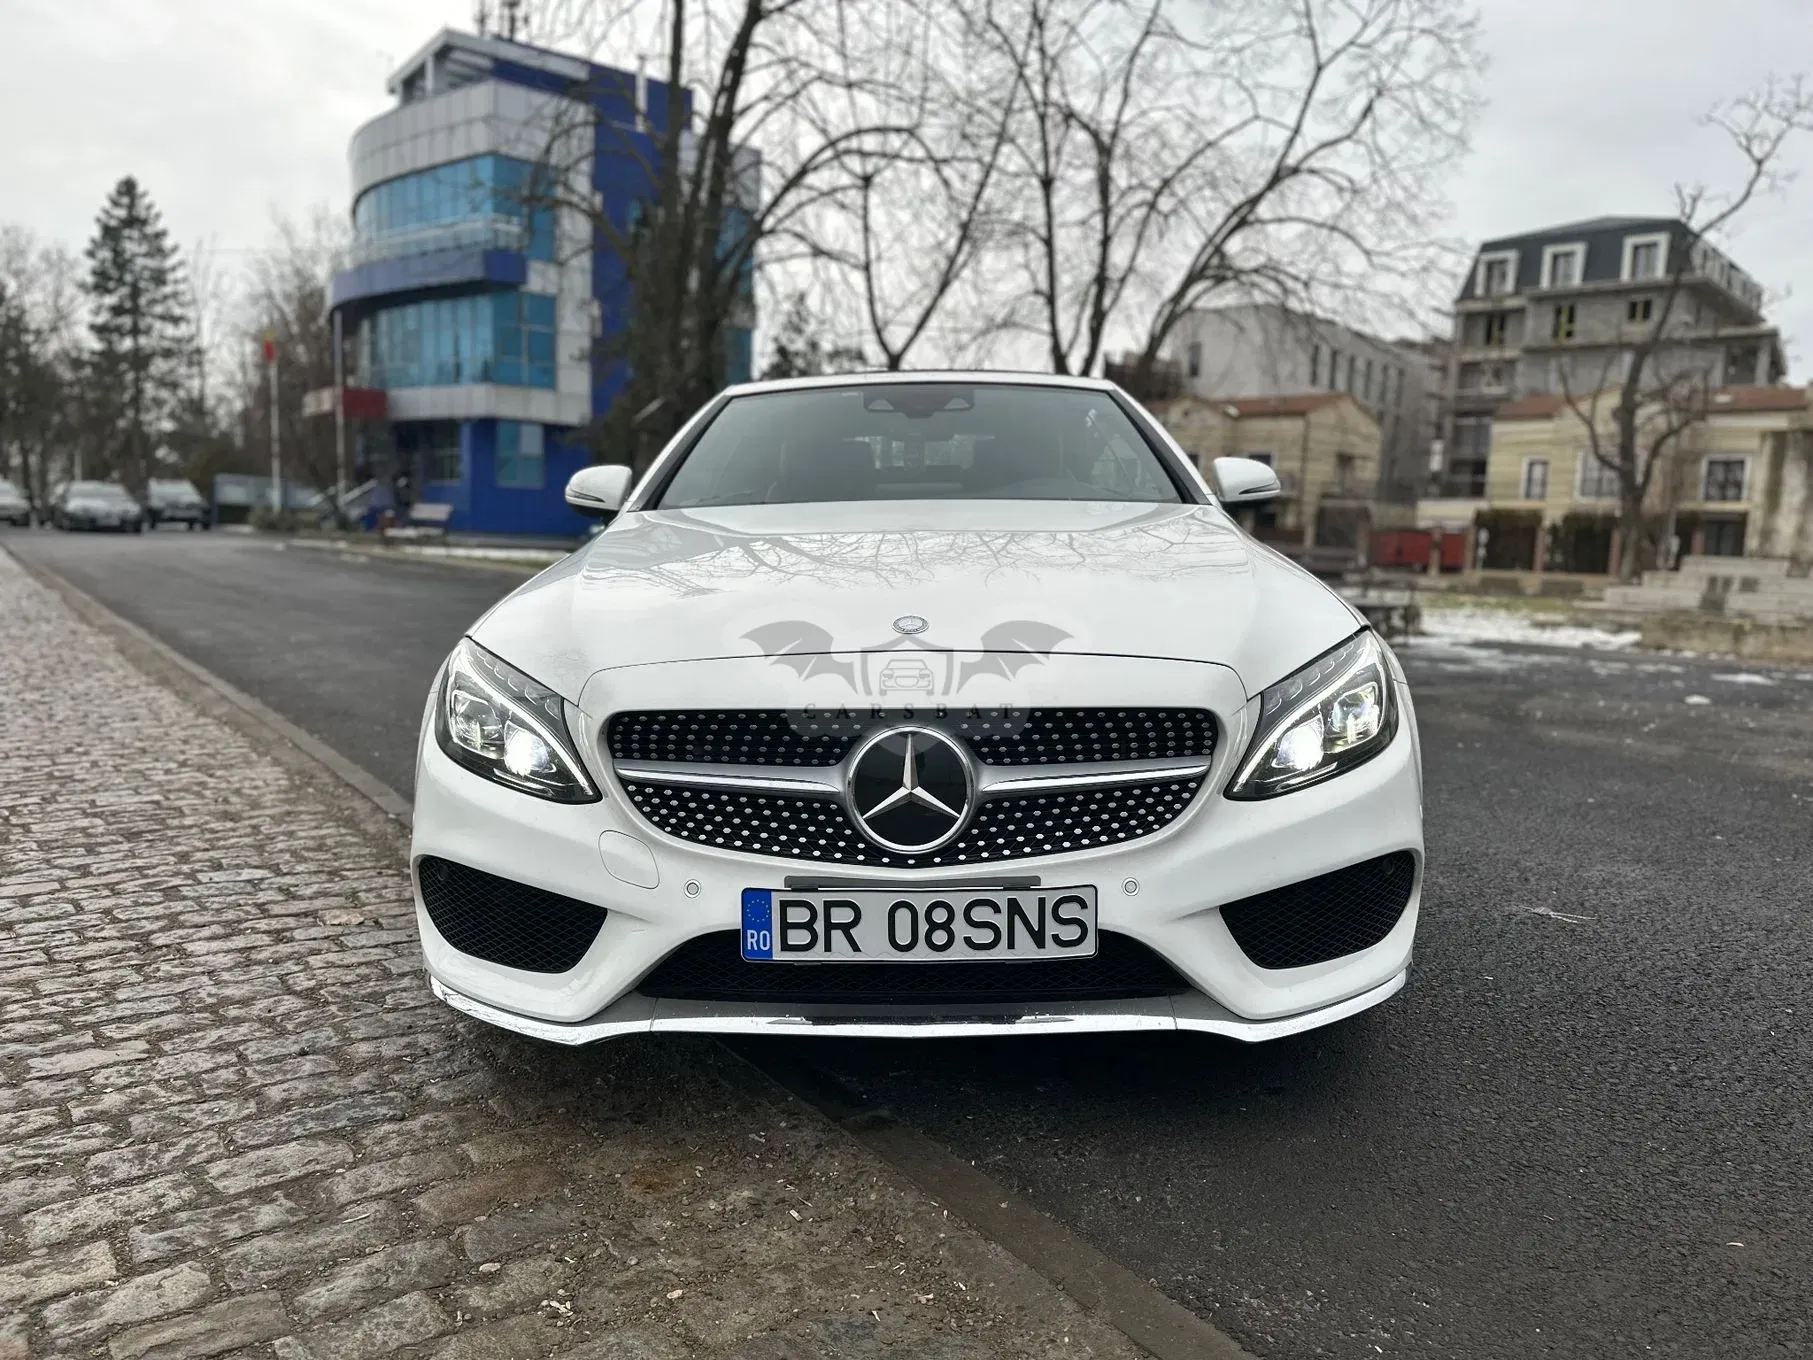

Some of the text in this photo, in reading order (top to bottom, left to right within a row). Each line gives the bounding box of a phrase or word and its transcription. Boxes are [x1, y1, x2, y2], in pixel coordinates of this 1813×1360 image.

[746, 929, 771, 951] RO
[779, 894, 1089, 953] BR 08SNS
